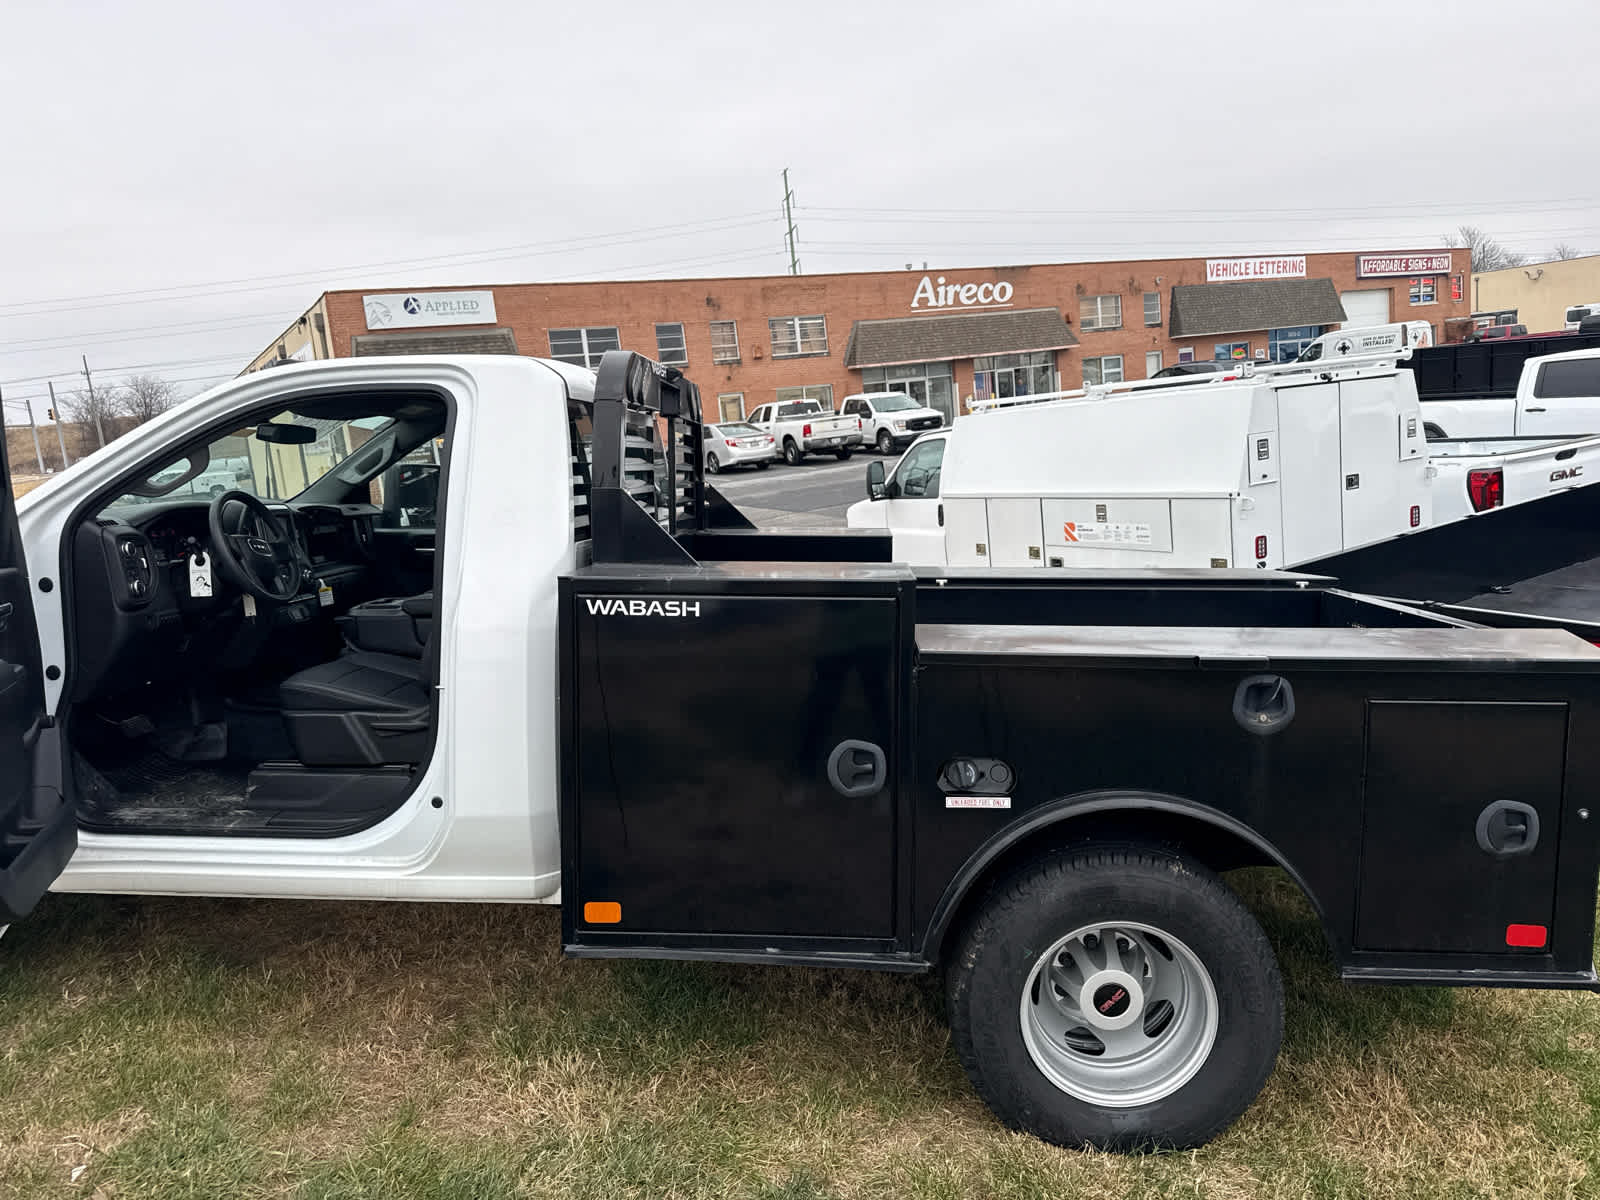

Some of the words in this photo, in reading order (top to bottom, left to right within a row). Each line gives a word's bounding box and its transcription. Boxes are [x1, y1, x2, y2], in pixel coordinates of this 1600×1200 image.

[1209, 262, 1249, 277] VEHICLE
[1253, 260, 1304, 275] LETTERING
[1364, 259, 1406, 272] AFFORDABLE
[1408, 258, 1426, 270] SIGNS
[1432, 257, 1448, 269] NEON
[911, 276, 1013, 307] Aireco
[1550, 466, 1583, 482] GMC
[586, 599, 700, 617] WABASH
[992, 799, 1004, 807] ONLY
[1099, 988, 1126, 1012] GMC
